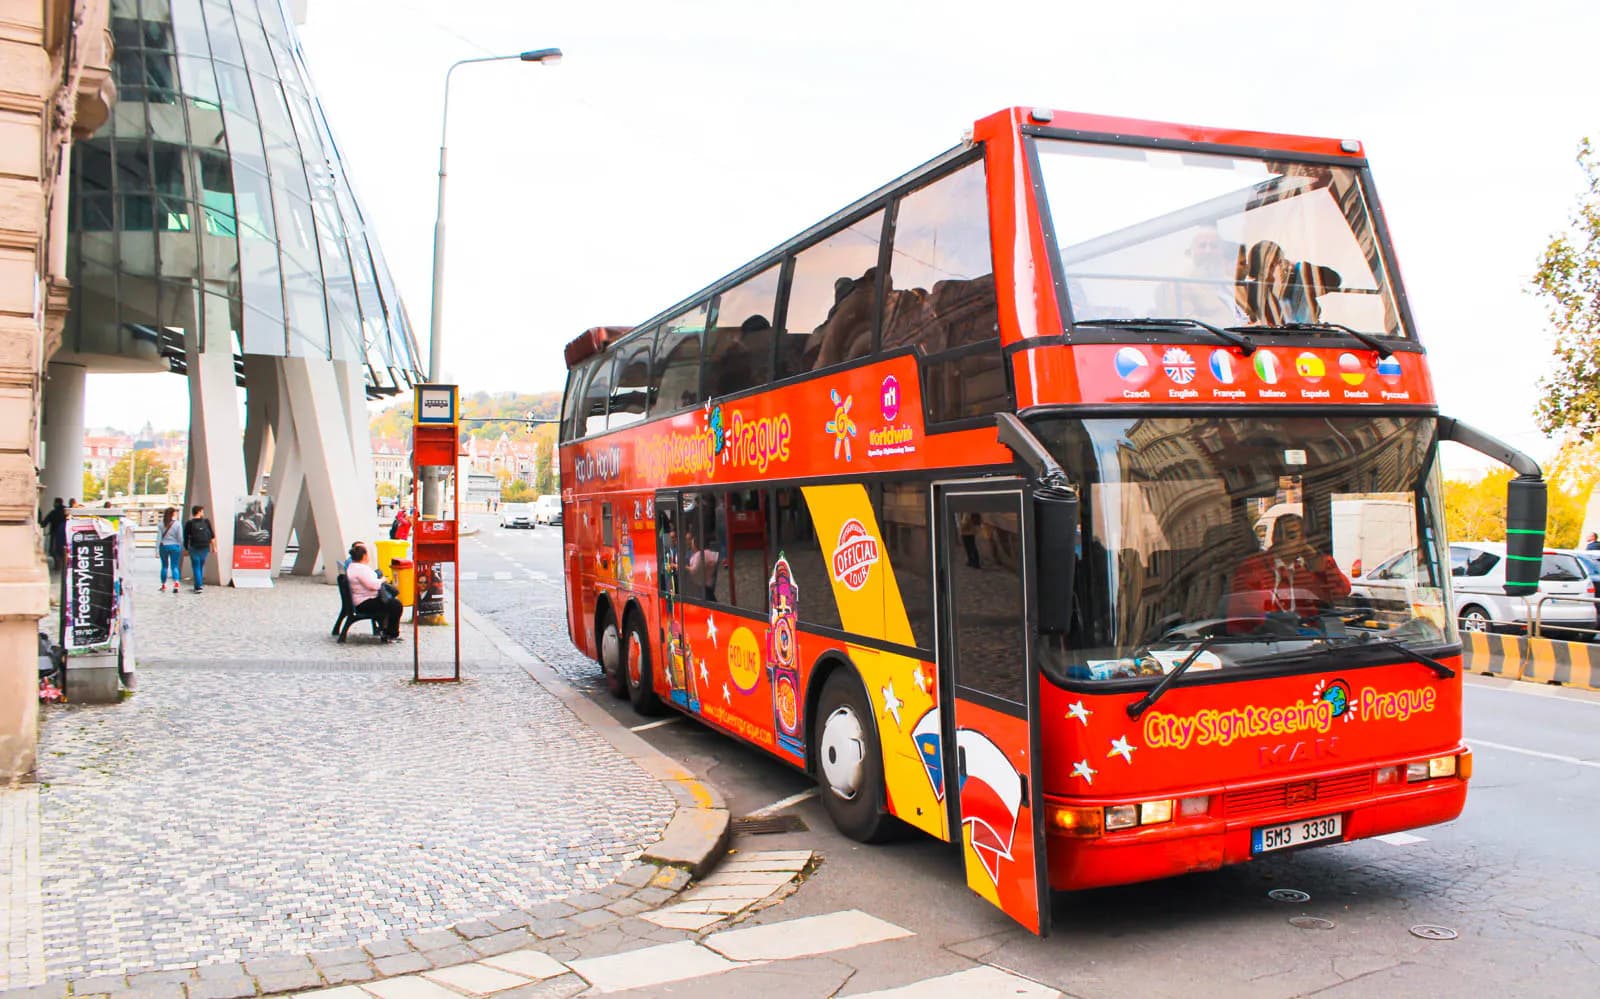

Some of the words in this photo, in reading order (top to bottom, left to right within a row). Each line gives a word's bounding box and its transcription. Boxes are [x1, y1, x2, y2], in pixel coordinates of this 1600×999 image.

[1122, 389, 1150, 398] Czech
[1168, 389, 1199, 399] English
[1213, 389, 1246, 399] Français
[1258, 389, 1287, 398] Italiano
[1301, 389, 1330, 398] Español
[731, 409, 791, 474] Prague
[94, 545, 104, 567] LIVE
[837, 541, 876, 572] OFFICIAL
[74, 546, 93, 626] Freestylers
[849, 568, 868, 585] TOUR
[1361, 686, 1436, 721] Prague
[1265, 827, 1292, 848] 5M3
[1302, 818, 1336, 841] 3330
